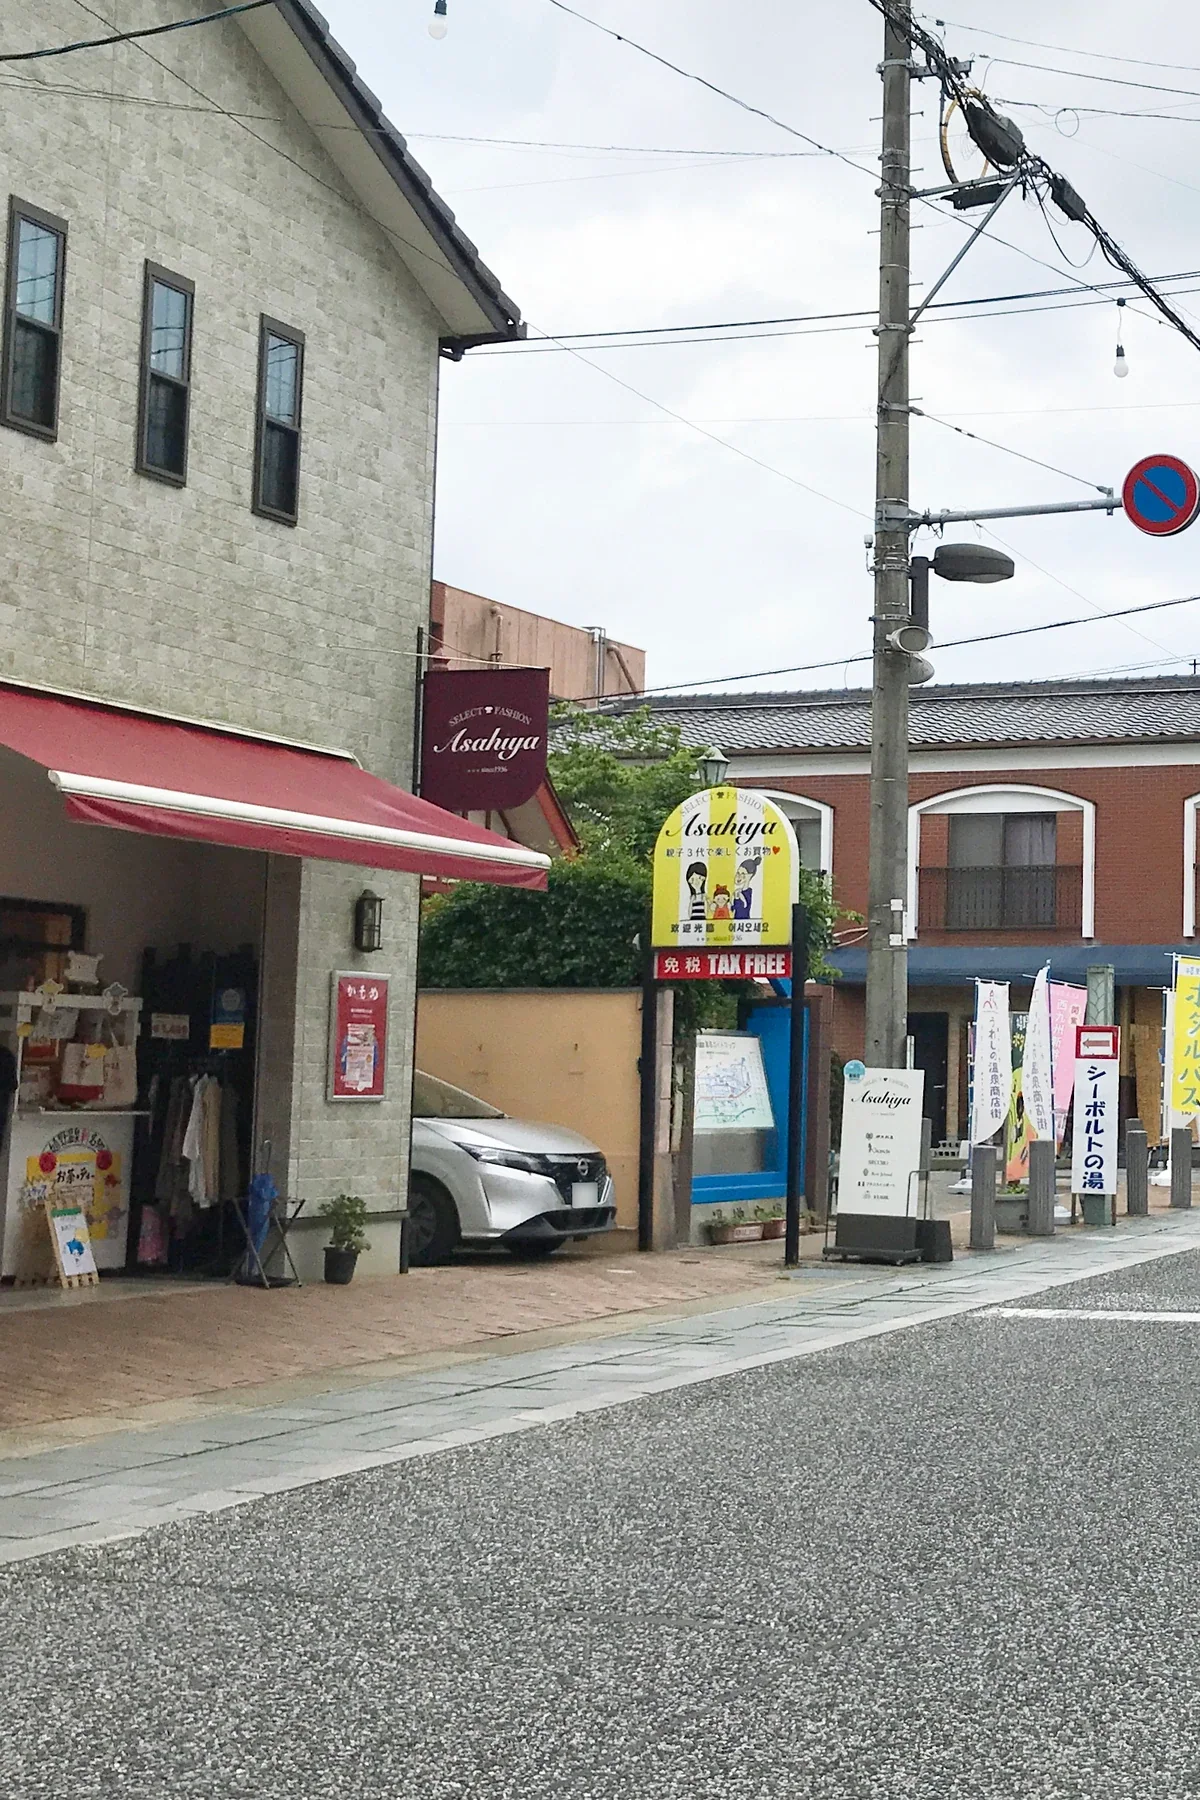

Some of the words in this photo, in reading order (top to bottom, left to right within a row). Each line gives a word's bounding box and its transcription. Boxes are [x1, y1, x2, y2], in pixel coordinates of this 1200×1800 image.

[448, 706, 484, 727] SELECT
[493, 706, 532, 725] FASHION
[433, 727, 540, 761] Asahiya
[682, 791, 715, 817] SELECT
[725, 791, 768, 816] FASHION
[665, 812, 778, 846] Asahiya
[664, 956, 701, 974] 免税
[707, 953, 742, 975] TAX
[744, 952, 786, 975] FREE
[851, 1089, 911, 1109] Asahiya
[1083, 1065, 1107, 1190] シーボルトの湯
